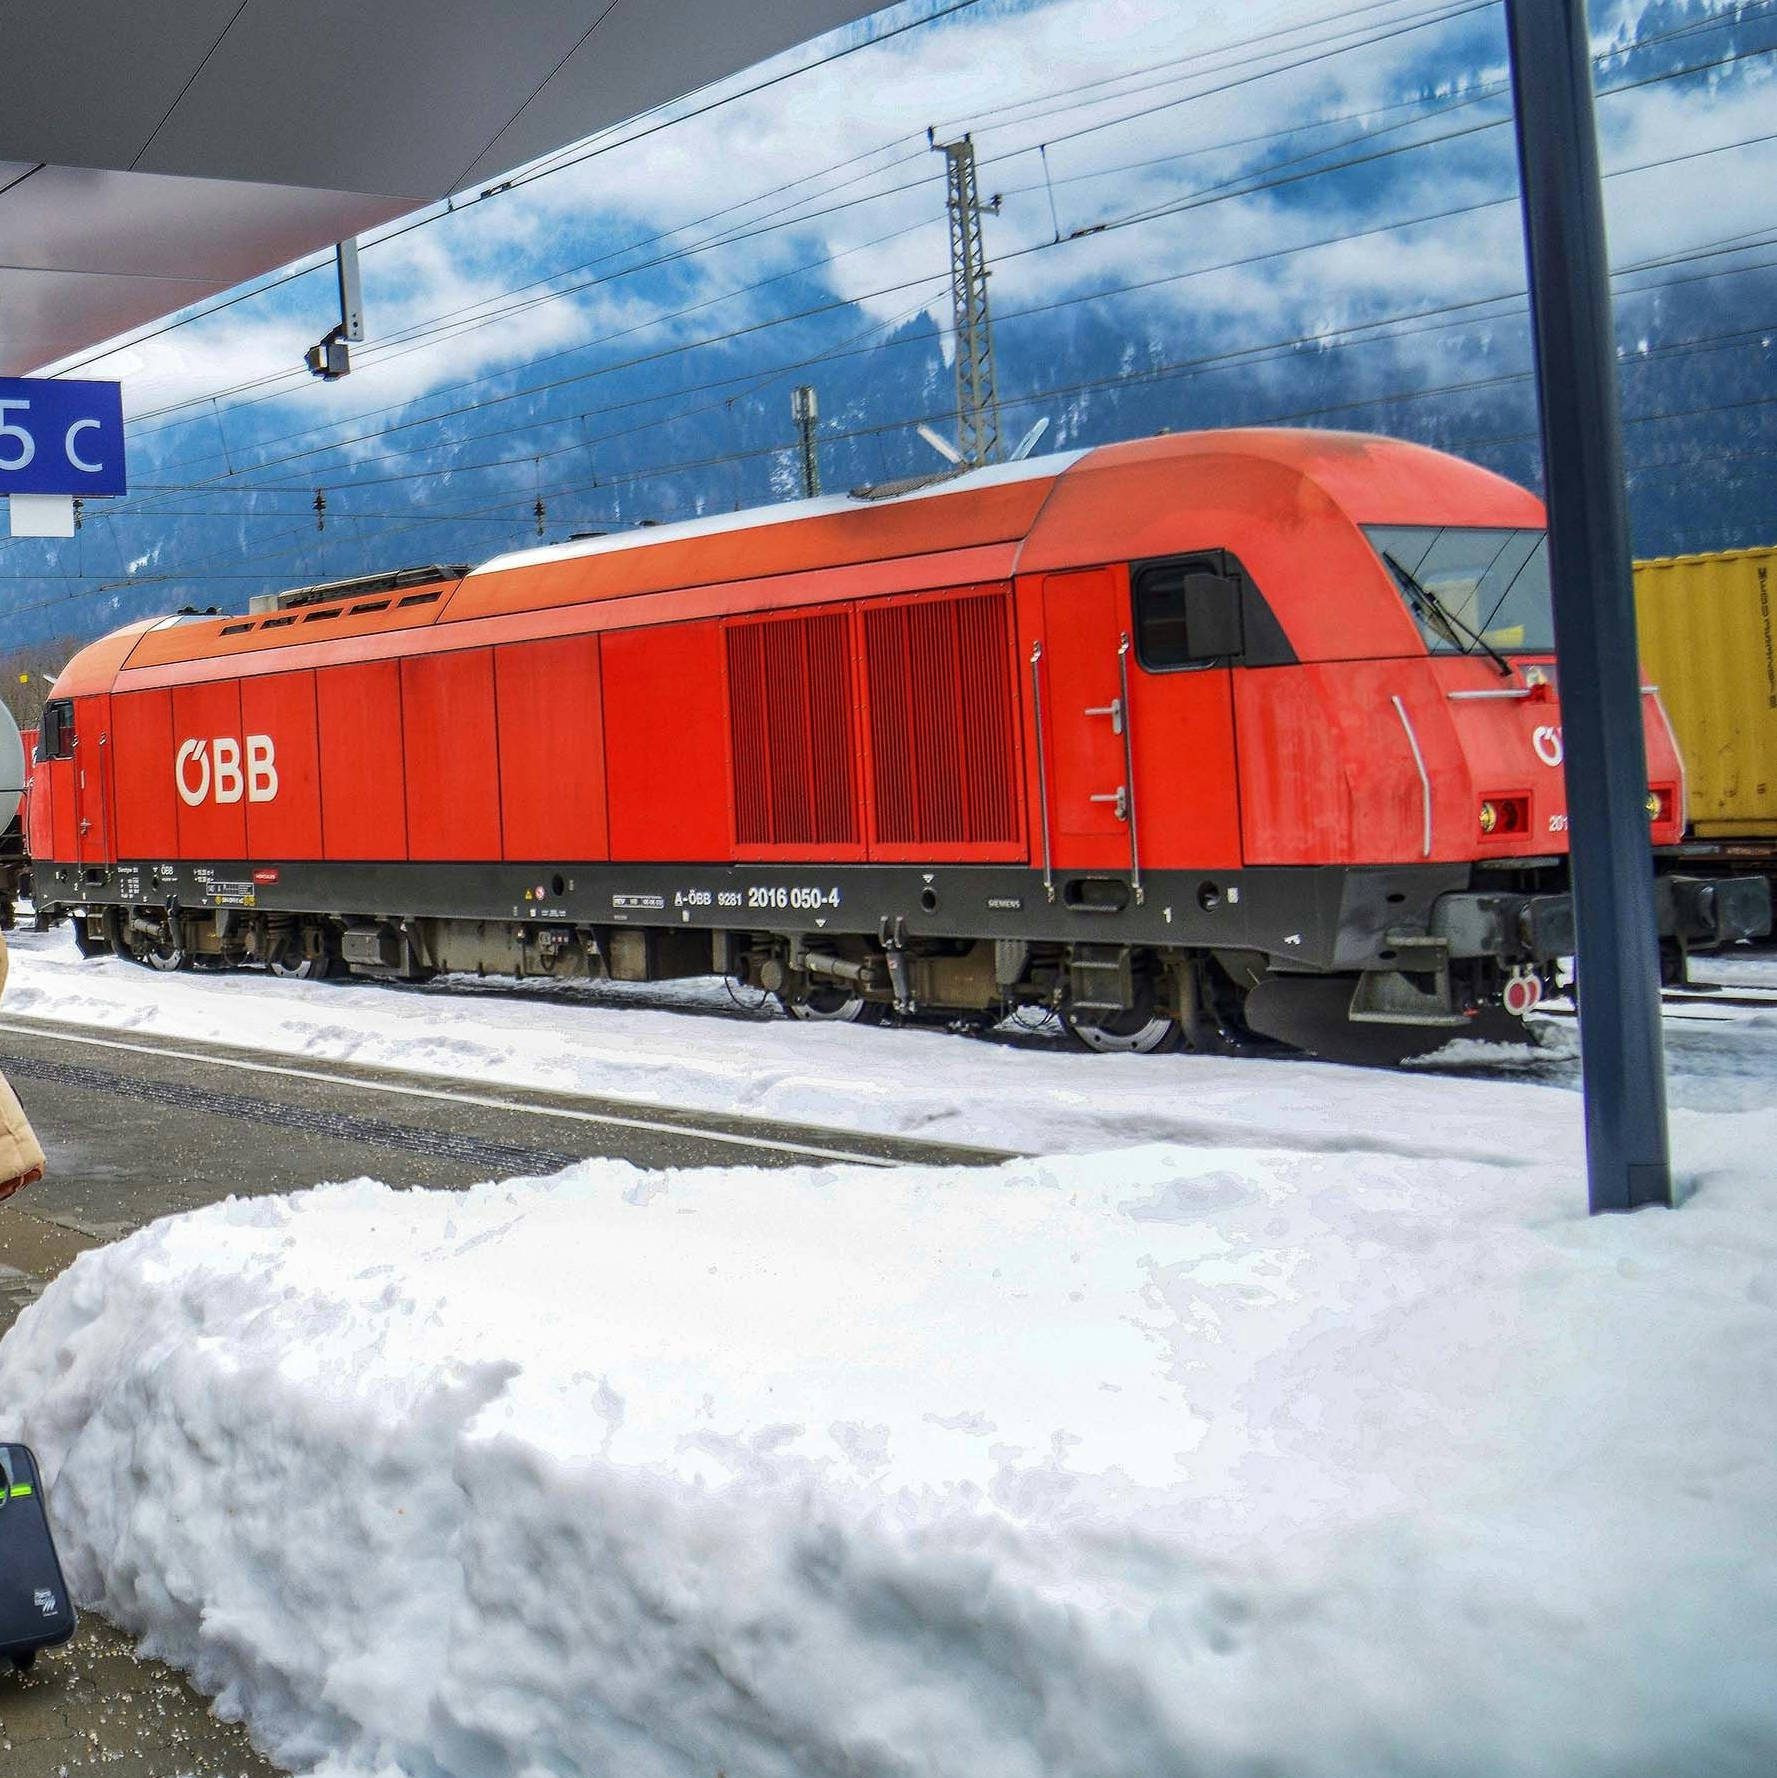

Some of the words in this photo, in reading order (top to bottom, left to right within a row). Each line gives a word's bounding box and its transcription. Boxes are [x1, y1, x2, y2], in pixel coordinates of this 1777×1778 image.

[64, 419, 103, 473] c
[175, 734, 279, 807] ÖBB
[1549, 814, 1568, 832] 201
[674, 888, 712, 907] A-ÖBB
[717, 891, 743, 907] 9281
[748, 886, 789, 909] 2016
[790, 886, 841, 909] 050-4
